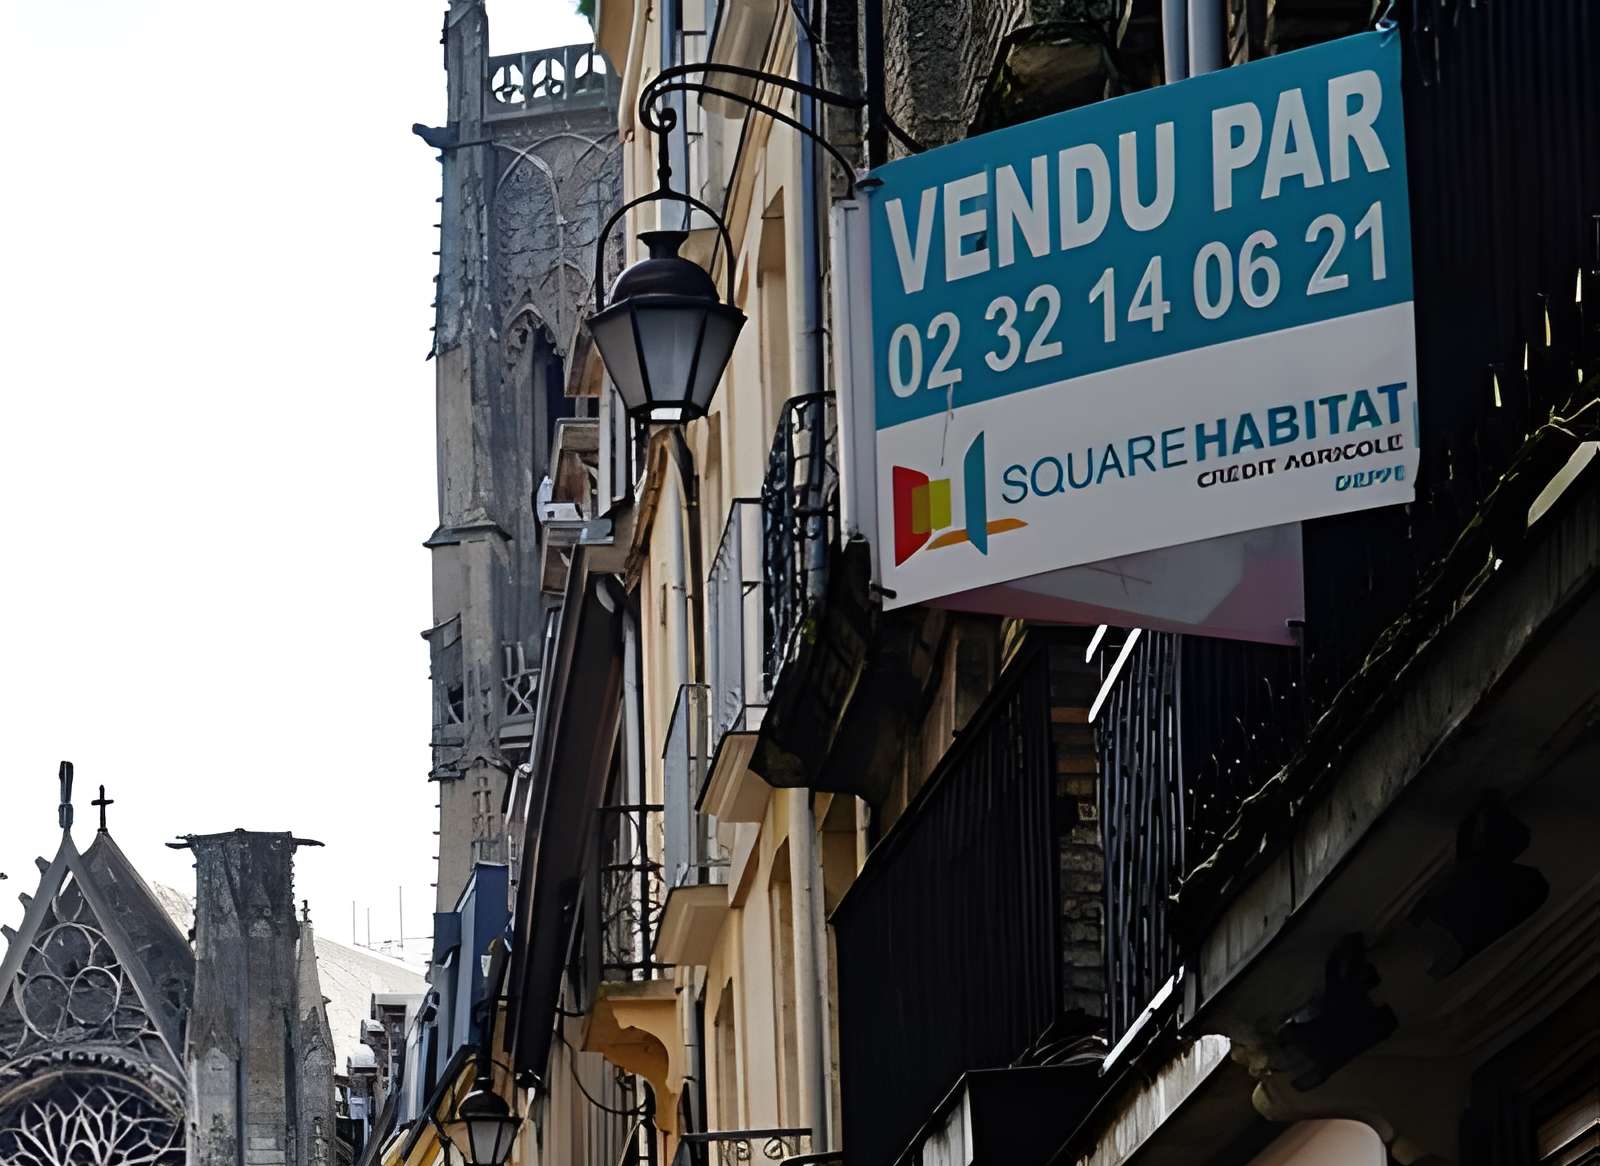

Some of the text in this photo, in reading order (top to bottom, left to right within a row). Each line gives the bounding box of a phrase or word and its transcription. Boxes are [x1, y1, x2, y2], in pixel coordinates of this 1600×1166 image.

[885, 69, 1390, 294] VENDU PAR
[888, 201, 1387, 398] 02 32 14 06 21
